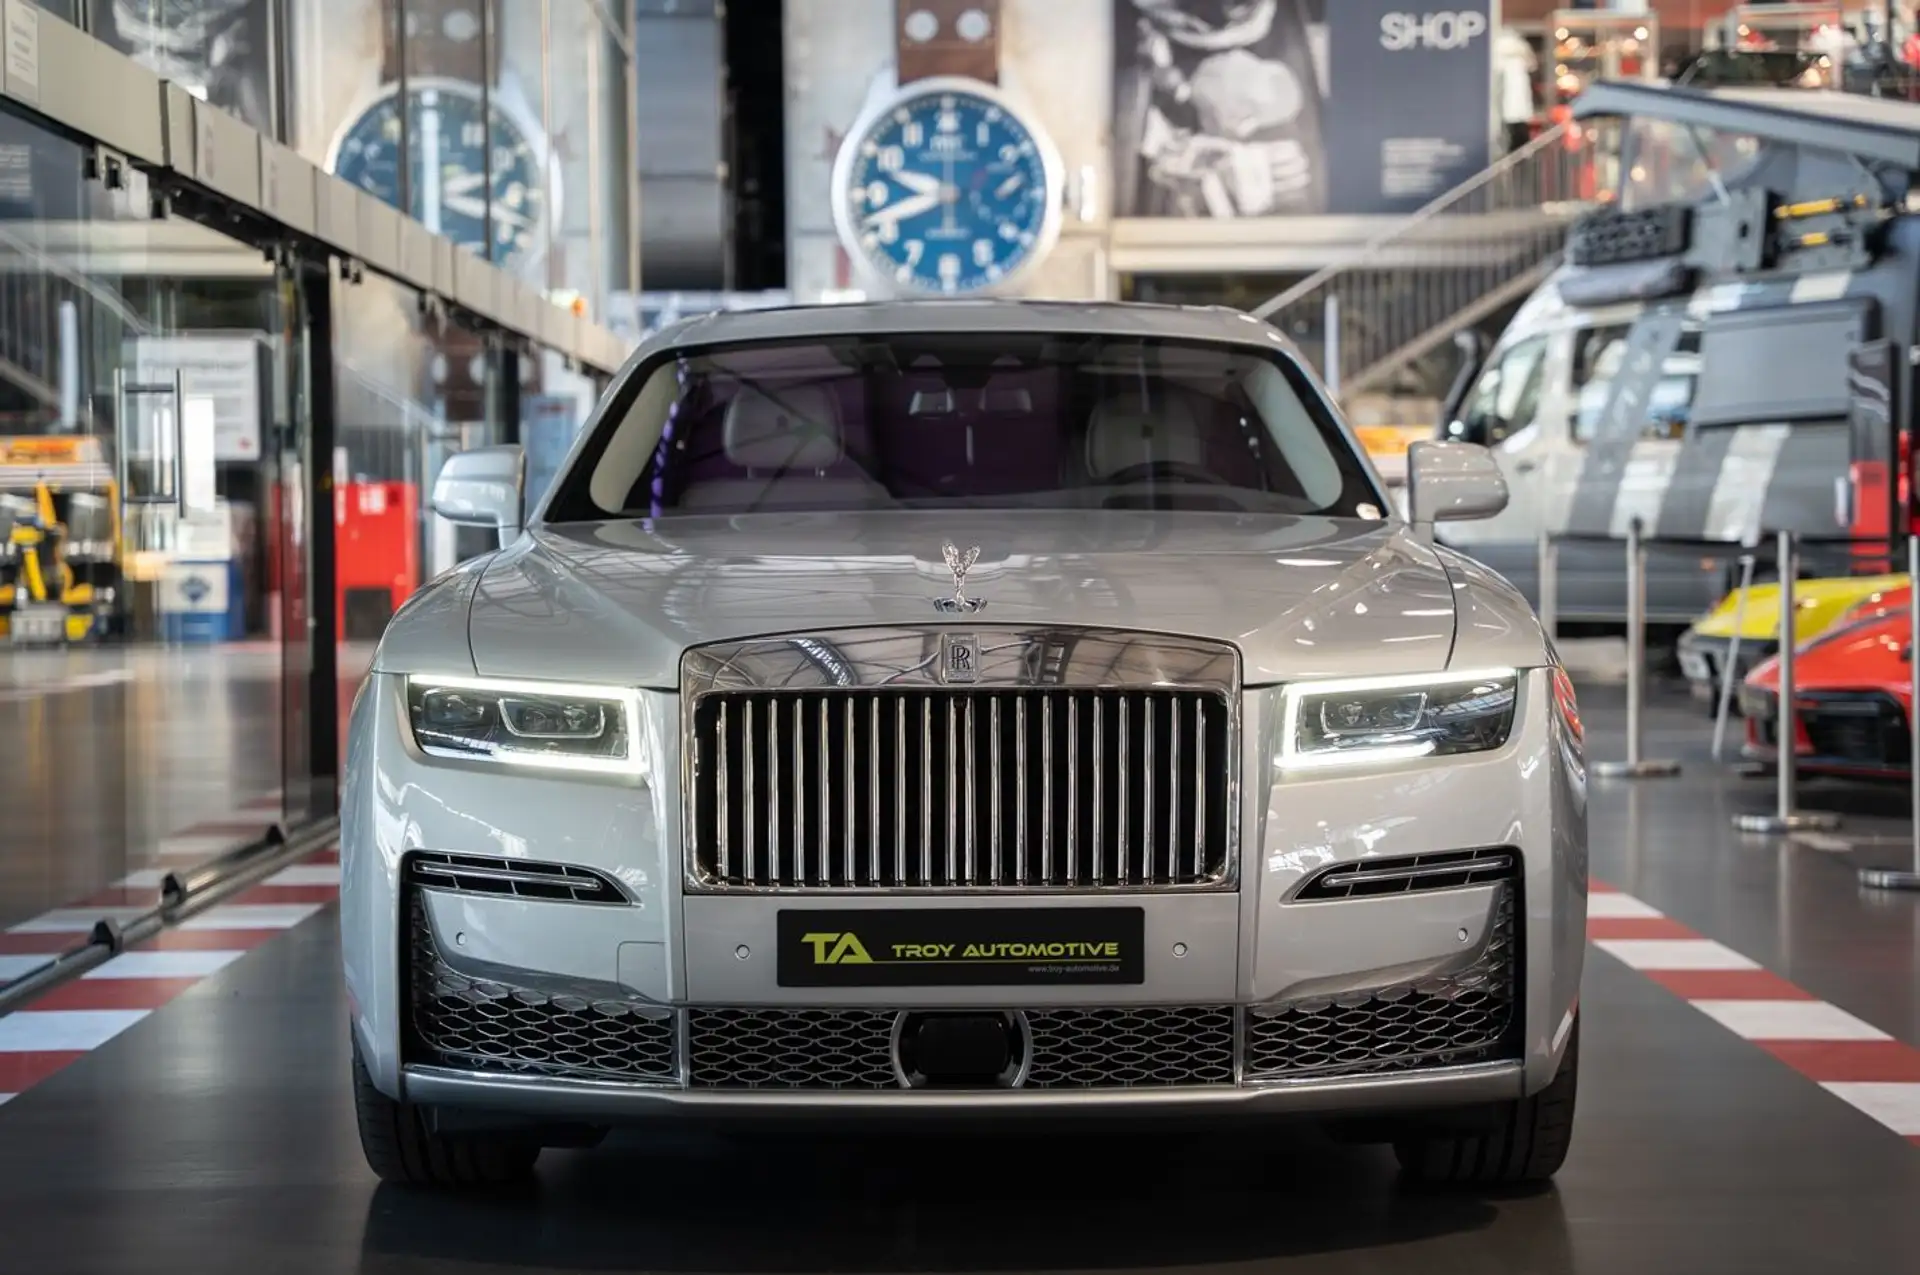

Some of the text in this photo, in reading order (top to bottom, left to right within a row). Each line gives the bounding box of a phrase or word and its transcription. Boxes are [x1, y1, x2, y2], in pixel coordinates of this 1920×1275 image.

[1379, 10, 1486, 50] SHOP
[801, 932, 1119, 964] TA TROY AUTOMOTIVE
[1028, 964, 1120, 976] www.troy-automotive.de
